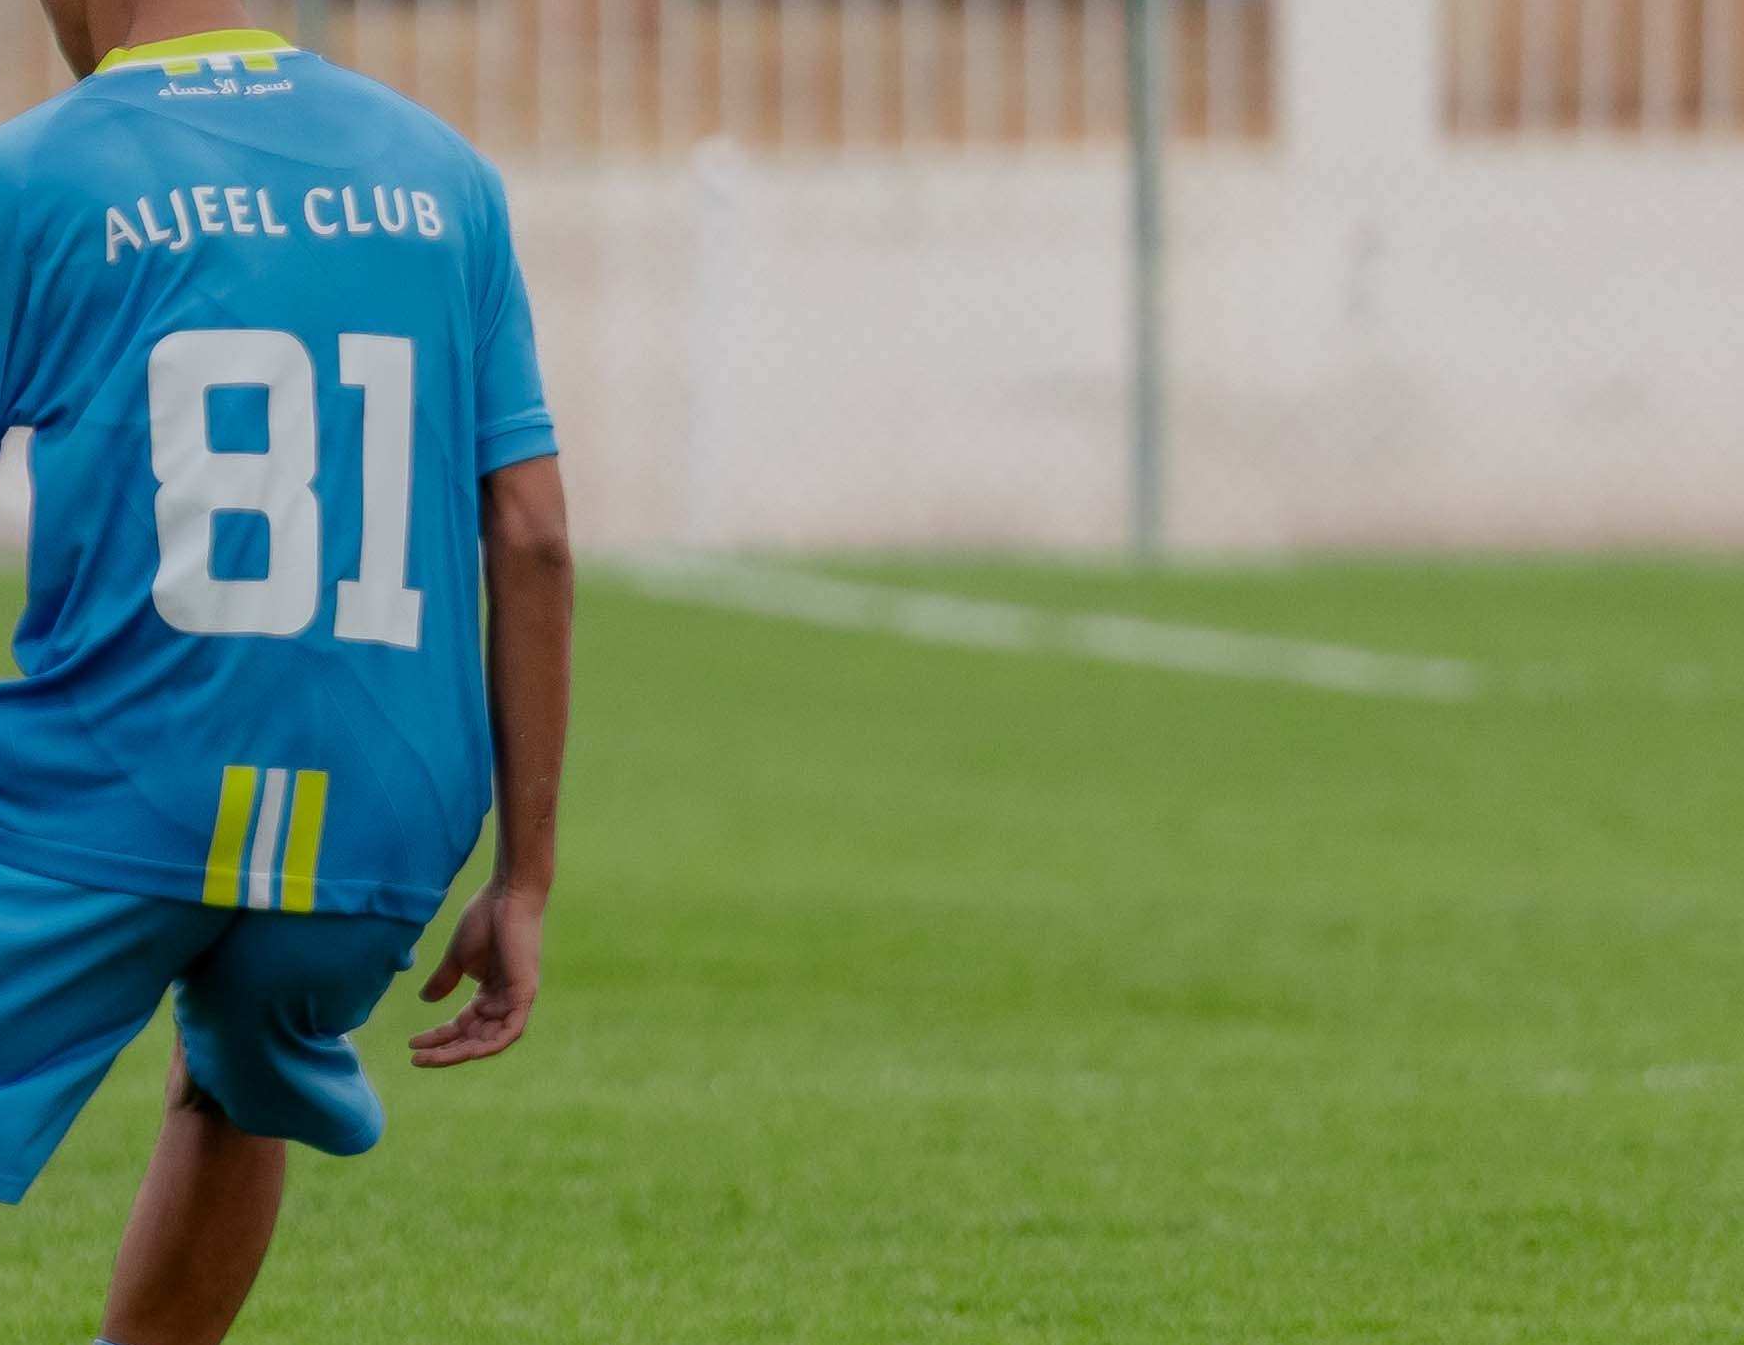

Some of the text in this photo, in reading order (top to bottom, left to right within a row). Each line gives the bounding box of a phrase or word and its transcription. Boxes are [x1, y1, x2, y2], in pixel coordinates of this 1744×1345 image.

[158, 78, 293, 96] نسور الأحساء
[105, 184, 442, 263] ALJEEL CLUB
[147, 329, 422, 649] 81
